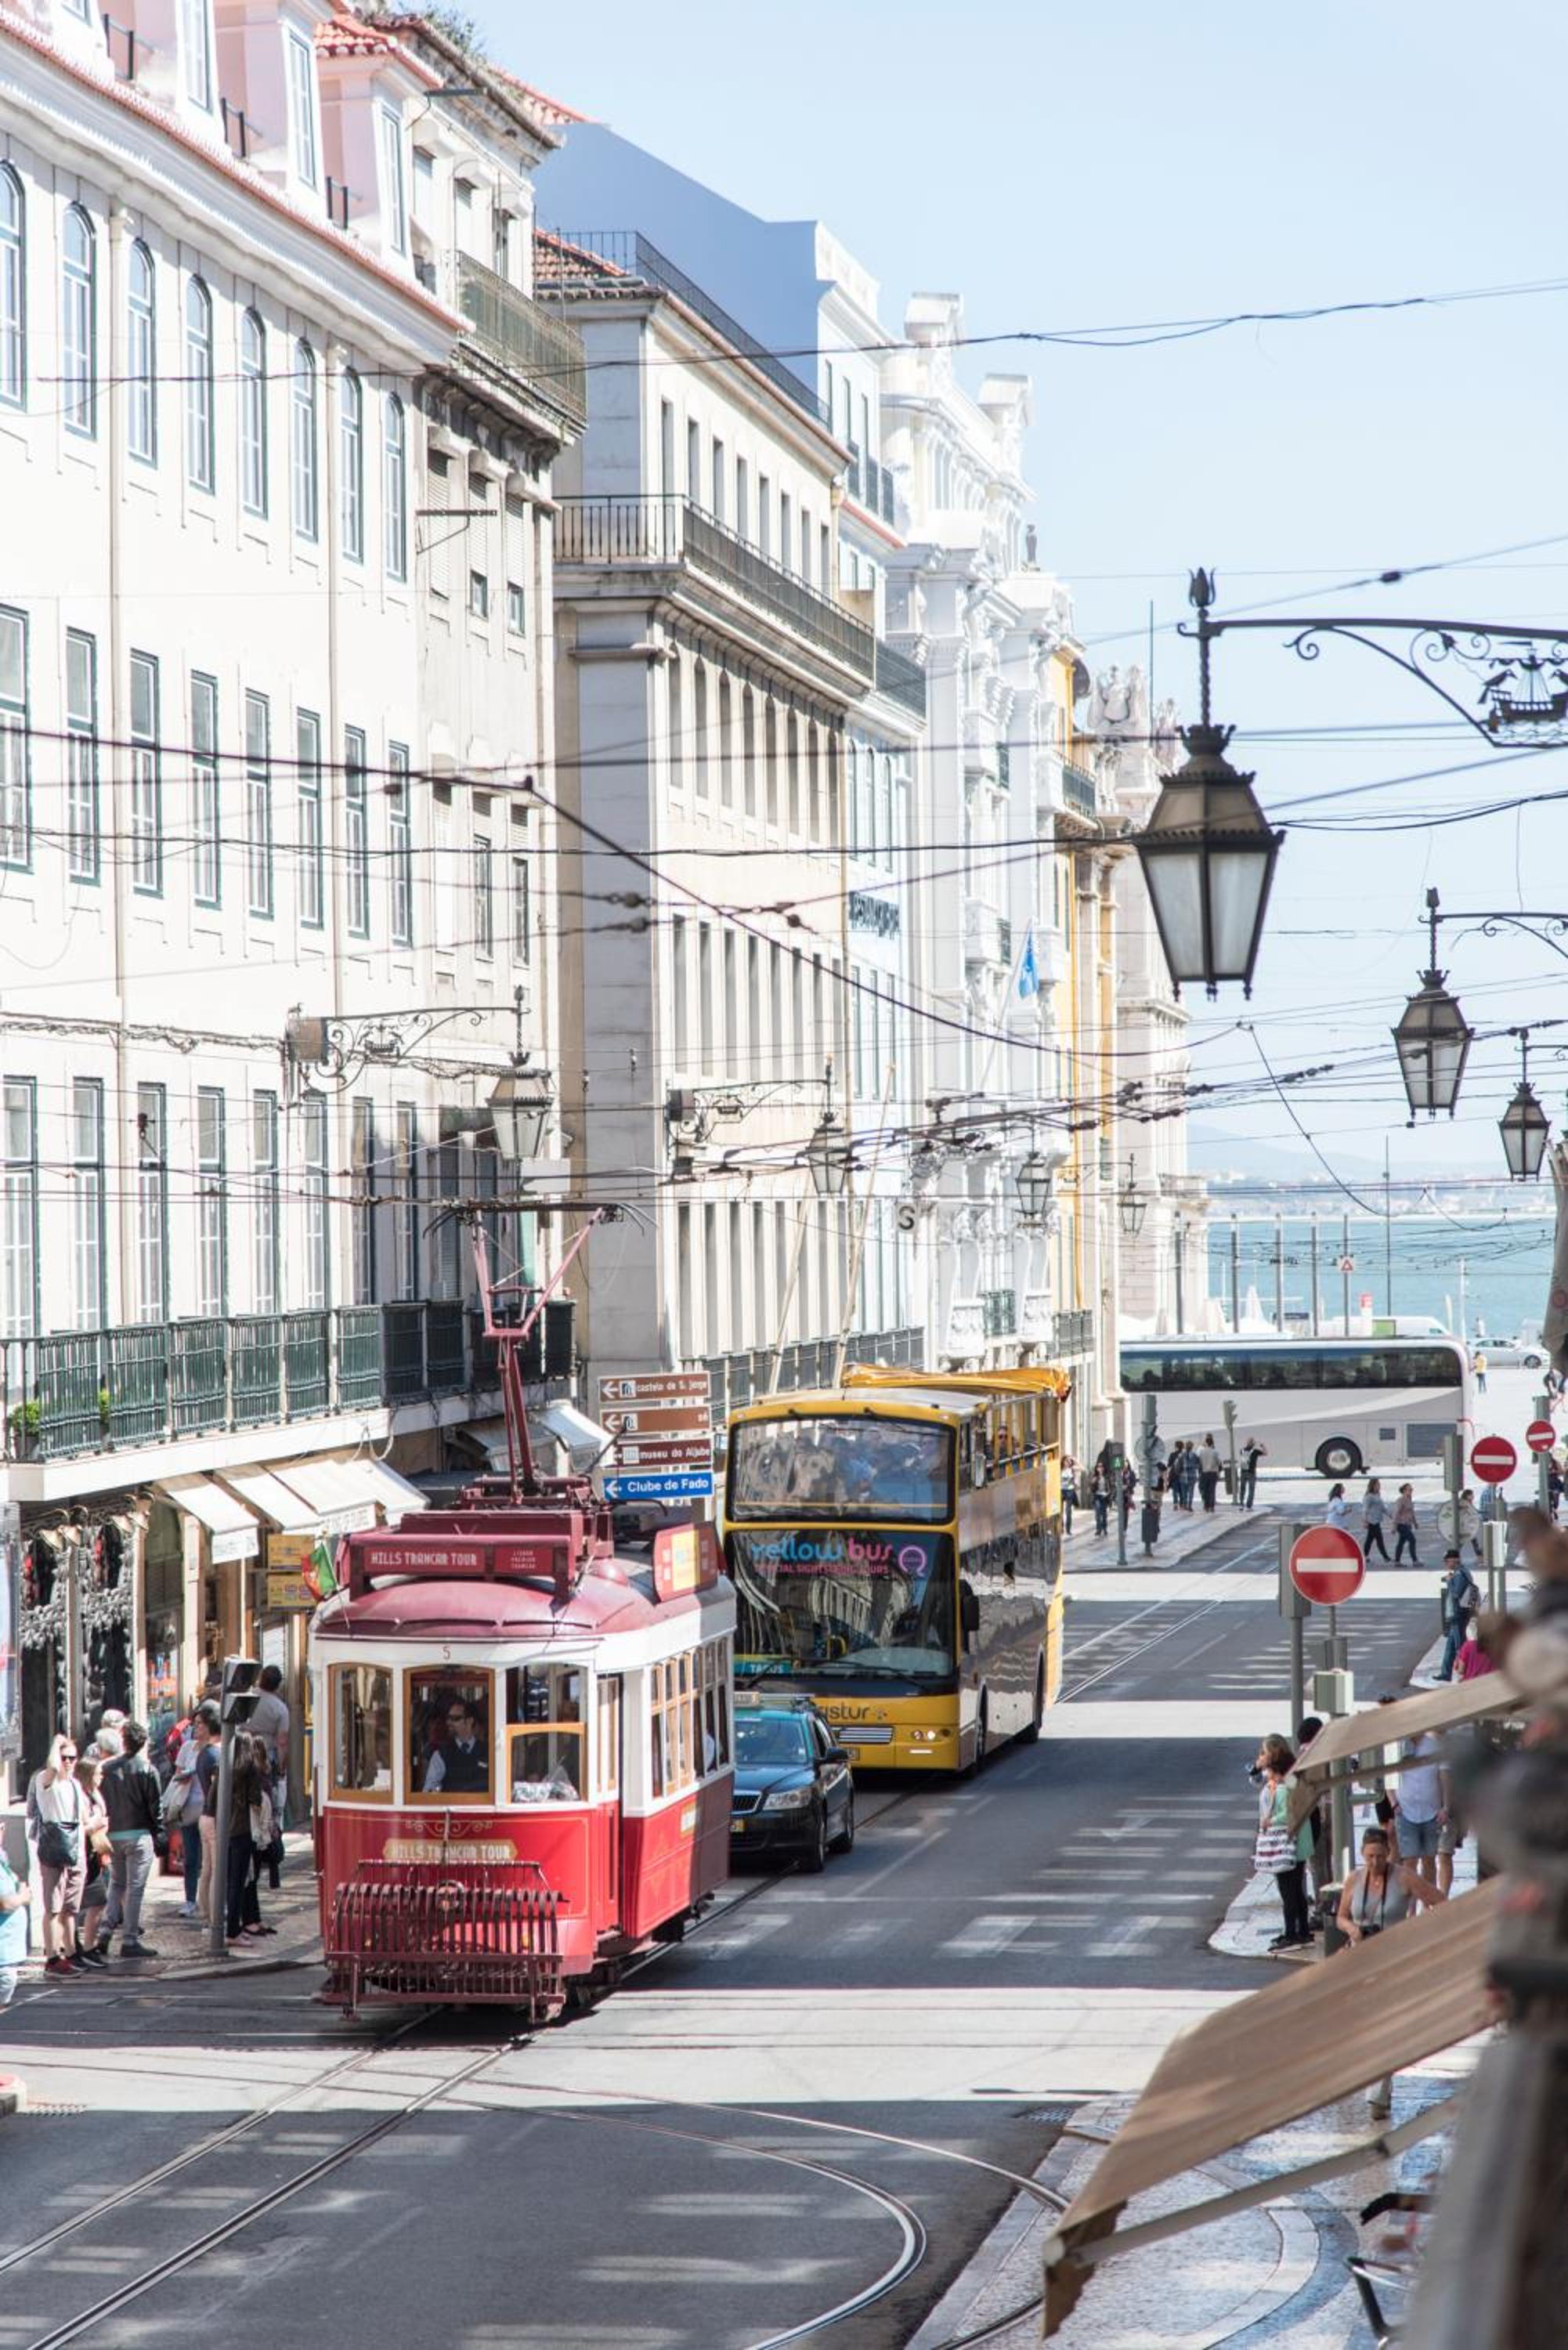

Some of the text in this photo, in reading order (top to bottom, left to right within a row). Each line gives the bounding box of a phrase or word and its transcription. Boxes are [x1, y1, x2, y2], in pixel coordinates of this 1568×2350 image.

[639, 1450, 668, 1460] museu
[627, 1477, 709, 1492] Clube de Fado
[847, 1537, 894, 1561] bus
[371, 1551, 401, 1565] HILLS
[451, 1553, 477, 1566] TOUR
[443, 1646, 450, 1661] 5
[392, 1844, 510, 1860] HILLS TRMCAR TOUR
